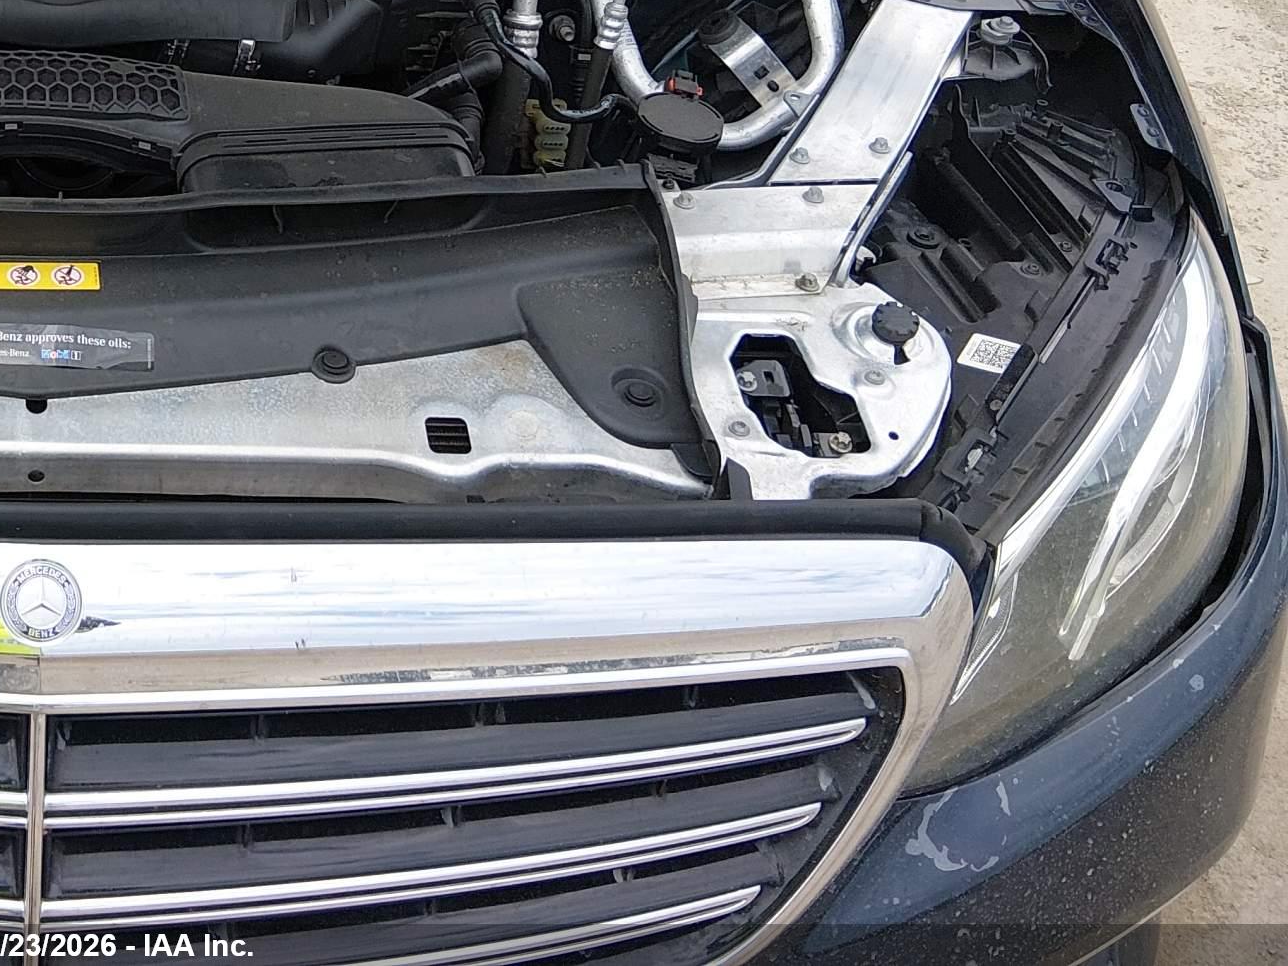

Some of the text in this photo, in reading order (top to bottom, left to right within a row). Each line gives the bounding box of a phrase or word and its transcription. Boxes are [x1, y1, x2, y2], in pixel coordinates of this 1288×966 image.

[25, 333, 74, 344] approves
[77, 334, 106, 346] these
[108, 338, 132, 349] oils:
[17, 566, 66, 585] MERCEDES
[28, 627, 56, 638] BENZ
